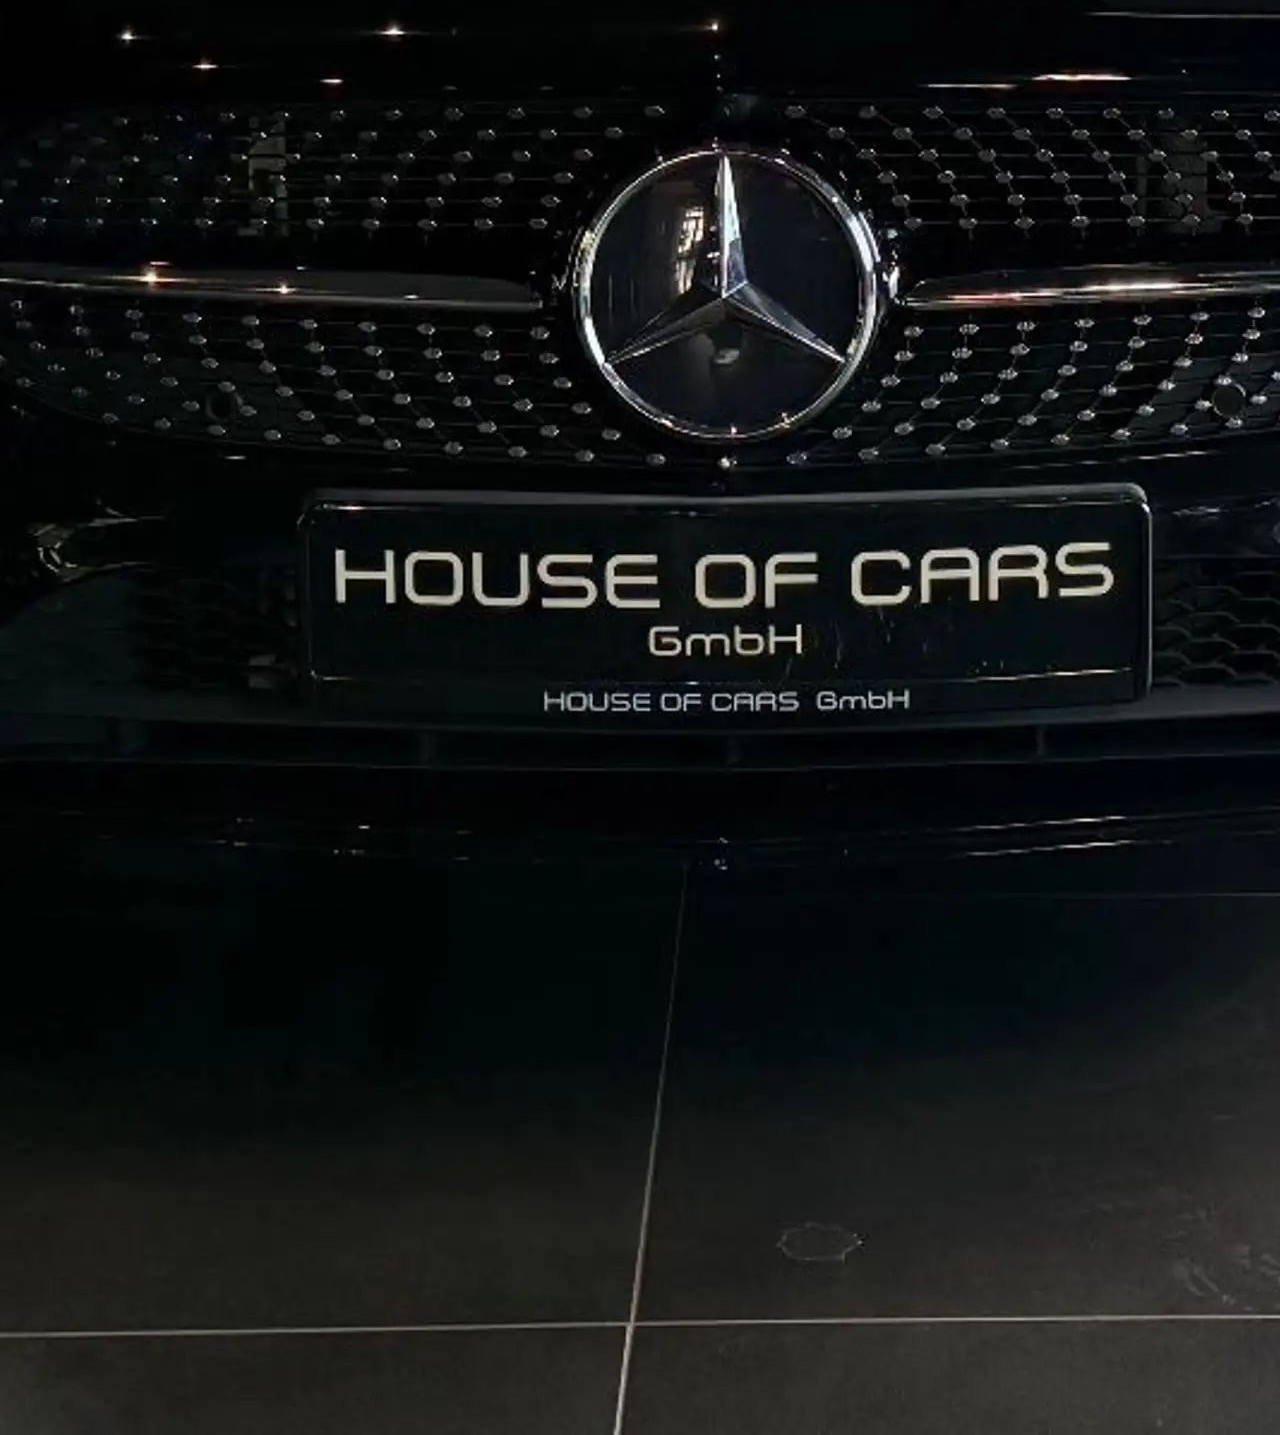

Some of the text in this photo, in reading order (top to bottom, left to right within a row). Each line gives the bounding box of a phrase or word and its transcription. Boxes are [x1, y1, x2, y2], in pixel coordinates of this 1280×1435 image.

[334, 541, 1115, 610] HOUSE OF CARS
[648, 622, 803, 657] GmbH
[543, 688, 911, 712] HOUSE OF CARS GmbH
